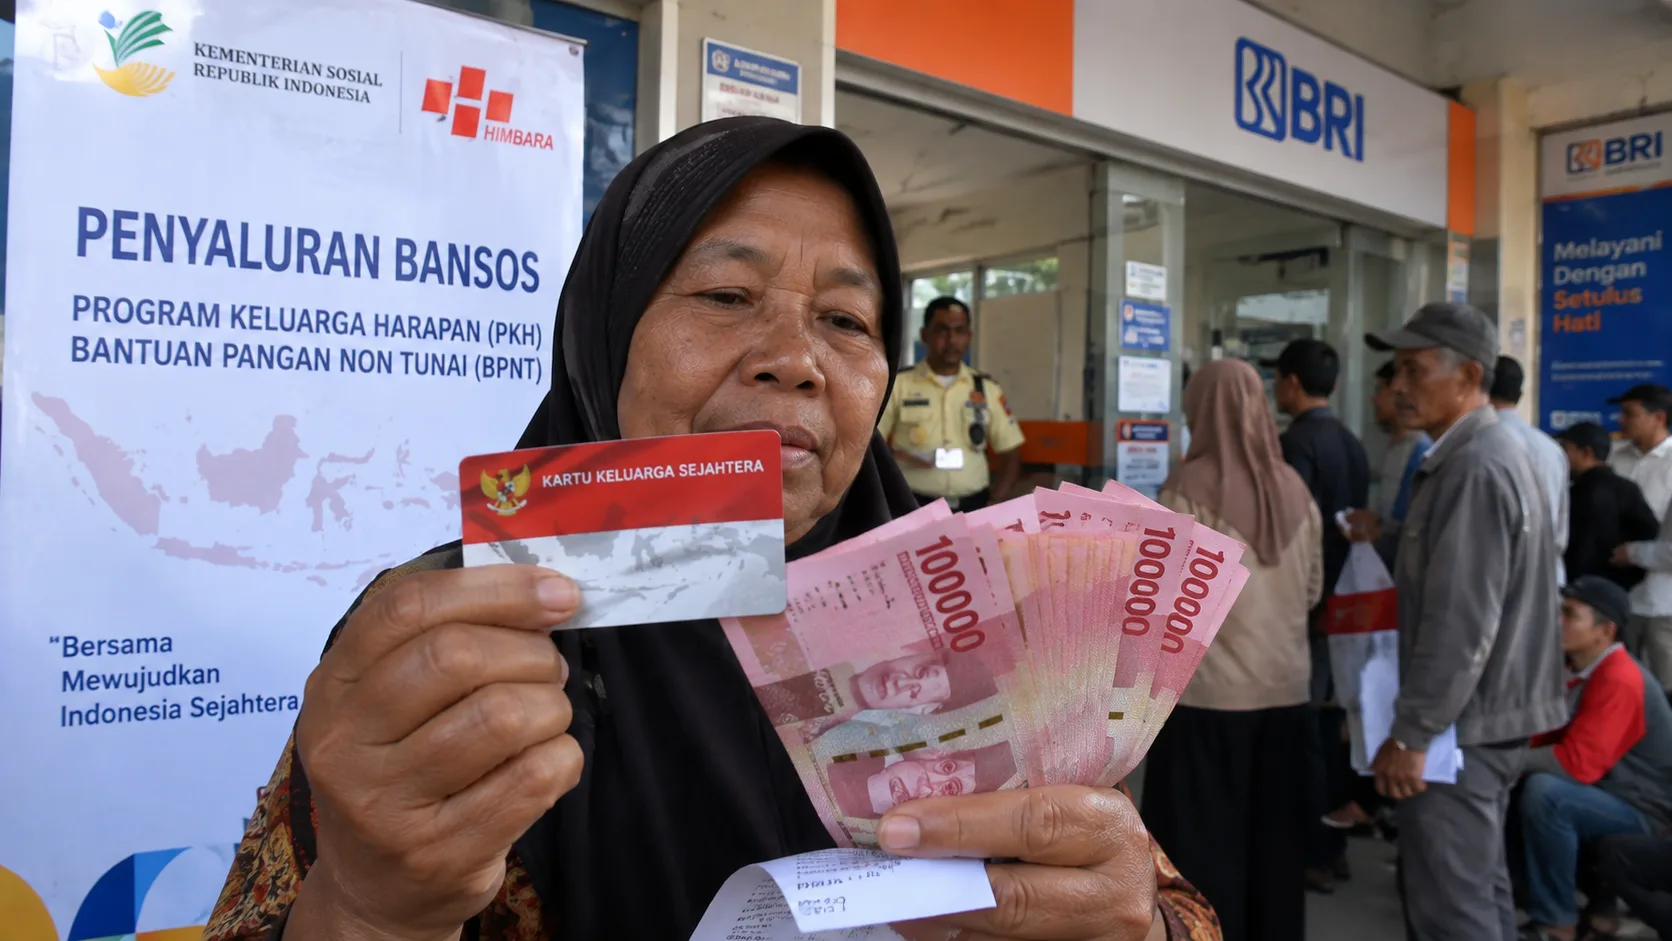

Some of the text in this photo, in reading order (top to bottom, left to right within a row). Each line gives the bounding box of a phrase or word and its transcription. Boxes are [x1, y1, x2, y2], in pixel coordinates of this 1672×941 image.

[193, 42, 383, 88] KEMENTERIAN SOSIAL
[193, 63, 371, 104] REPUBLIK INDONESIA
[1290, 67, 1364, 162] BRI
[483, 124, 554, 151] HIMBARA
[1604, 130, 1662, 165] BRI
[76, 206, 541, 293] PENYALURAN BANSOS
[1553, 230, 1663, 262] Melayani
[1553, 261, 1647, 286] Dengan
[1553, 285, 1643, 310] Setulus
[72, 294, 543, 350] PROGRAM KELUARGA HARAPAN (PKH)
[1552, 311, 1601, 333] Hati
[71, 336, 543, 384] BANTUAN PANGAN NON TUNAI (BPNT)
[542, 459, 764, 488] KARTU KELUARGA SEJAHTERA
[915, 535, 986, 653] 100000
[1122, 527, 1176, 636] 100000
[61, 664, 220, 694] Mewujudkan
[60, 692, 299, 727] Indonesia Sejahtera
